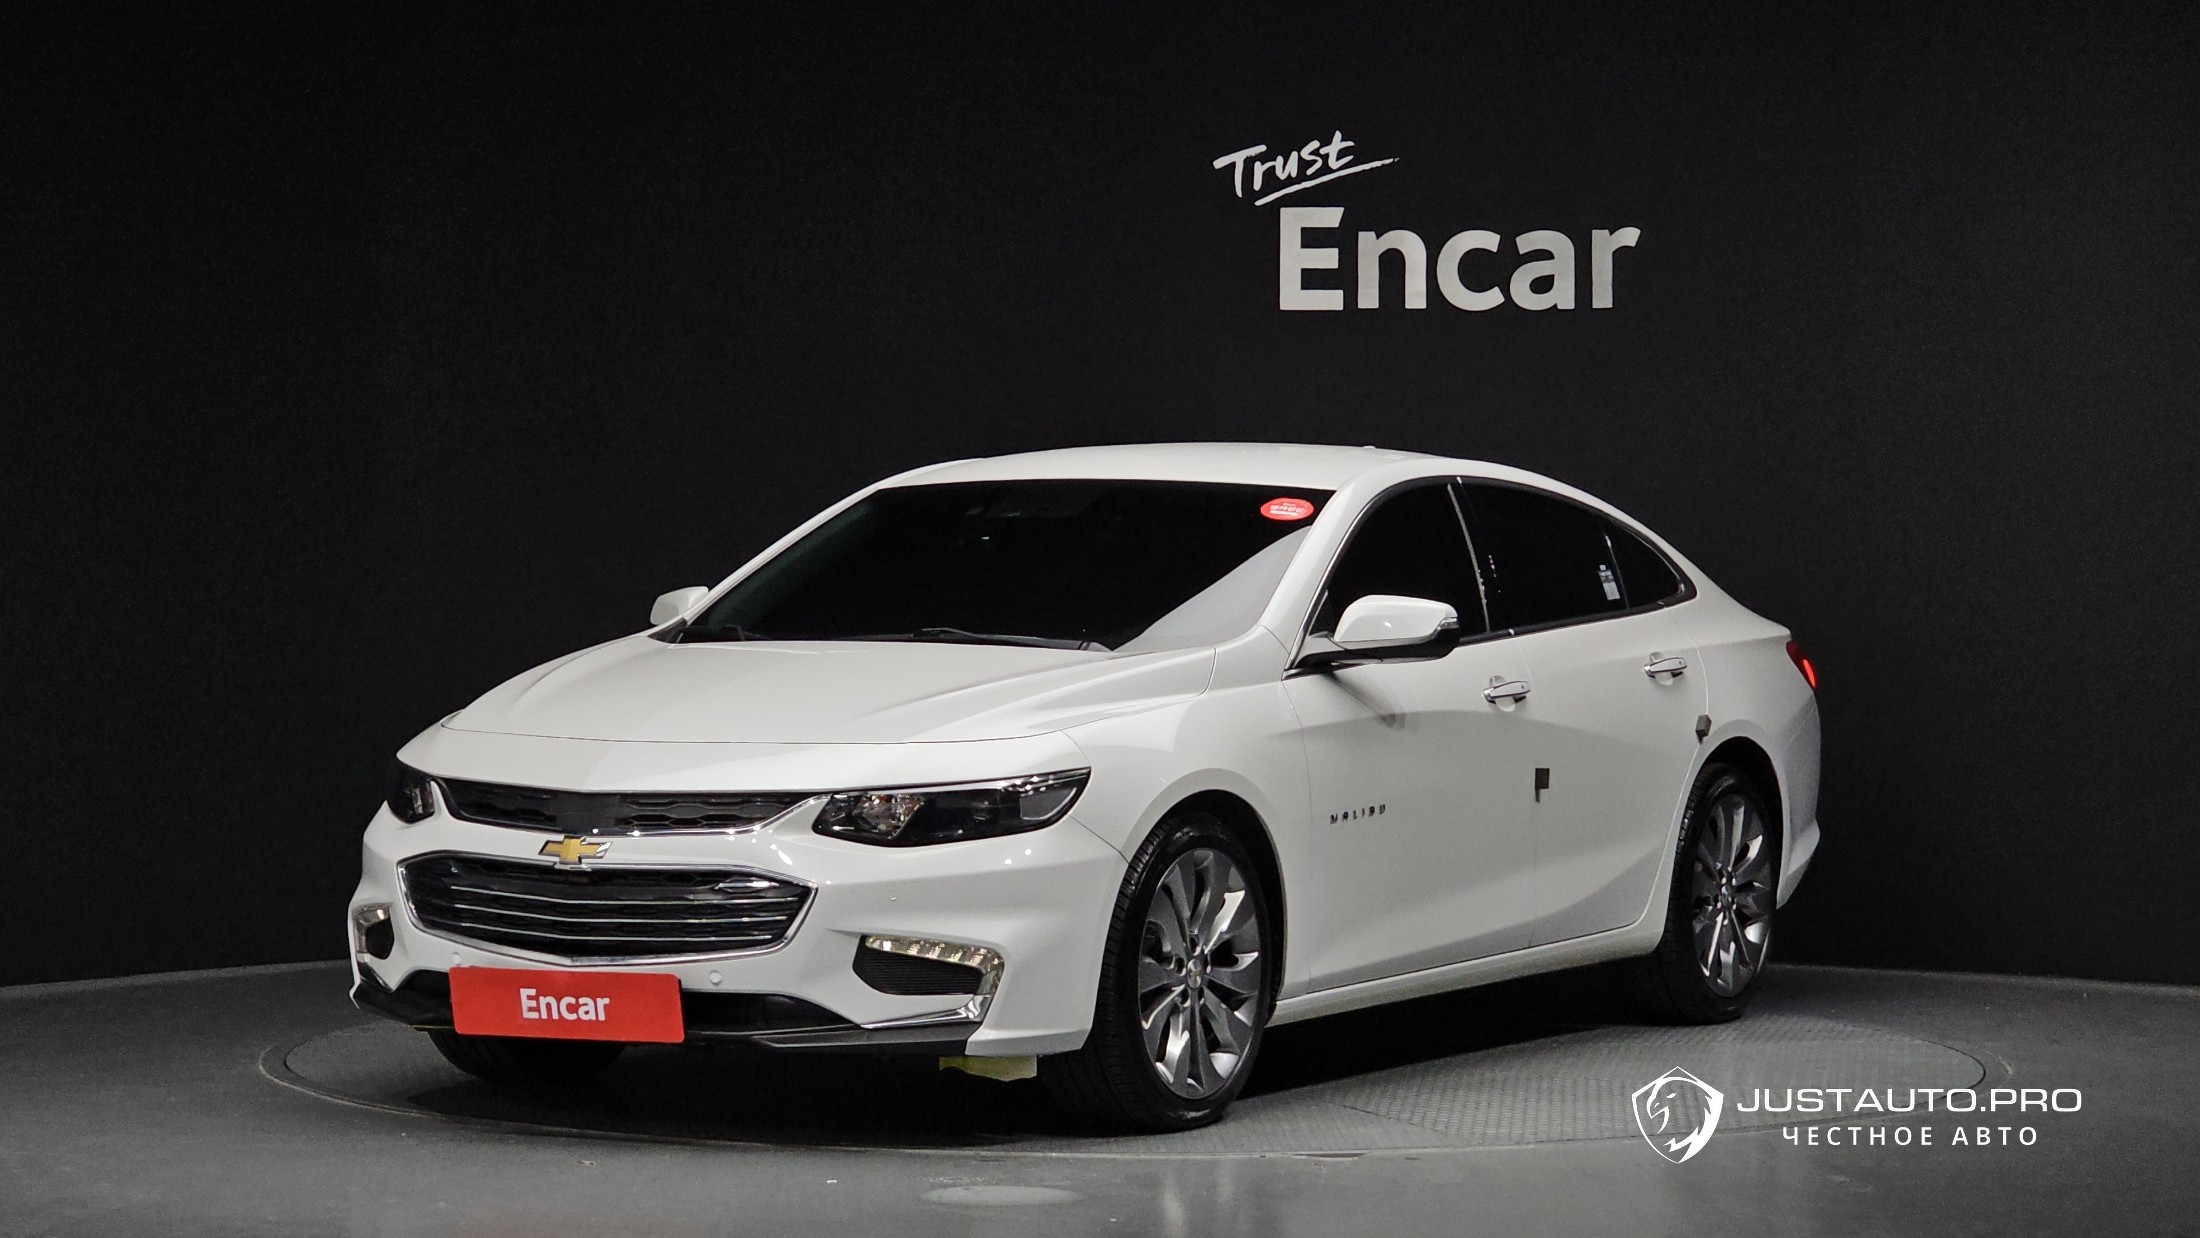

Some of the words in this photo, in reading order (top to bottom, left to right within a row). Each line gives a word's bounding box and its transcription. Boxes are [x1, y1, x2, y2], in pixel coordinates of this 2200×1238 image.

[1213, 131, 1354, 198] Trust
[1280, 207, 1642, 312] Encar
[1329, 803, 1386, 825] MALIBU
[520, 988, 610, 1021] Encar
